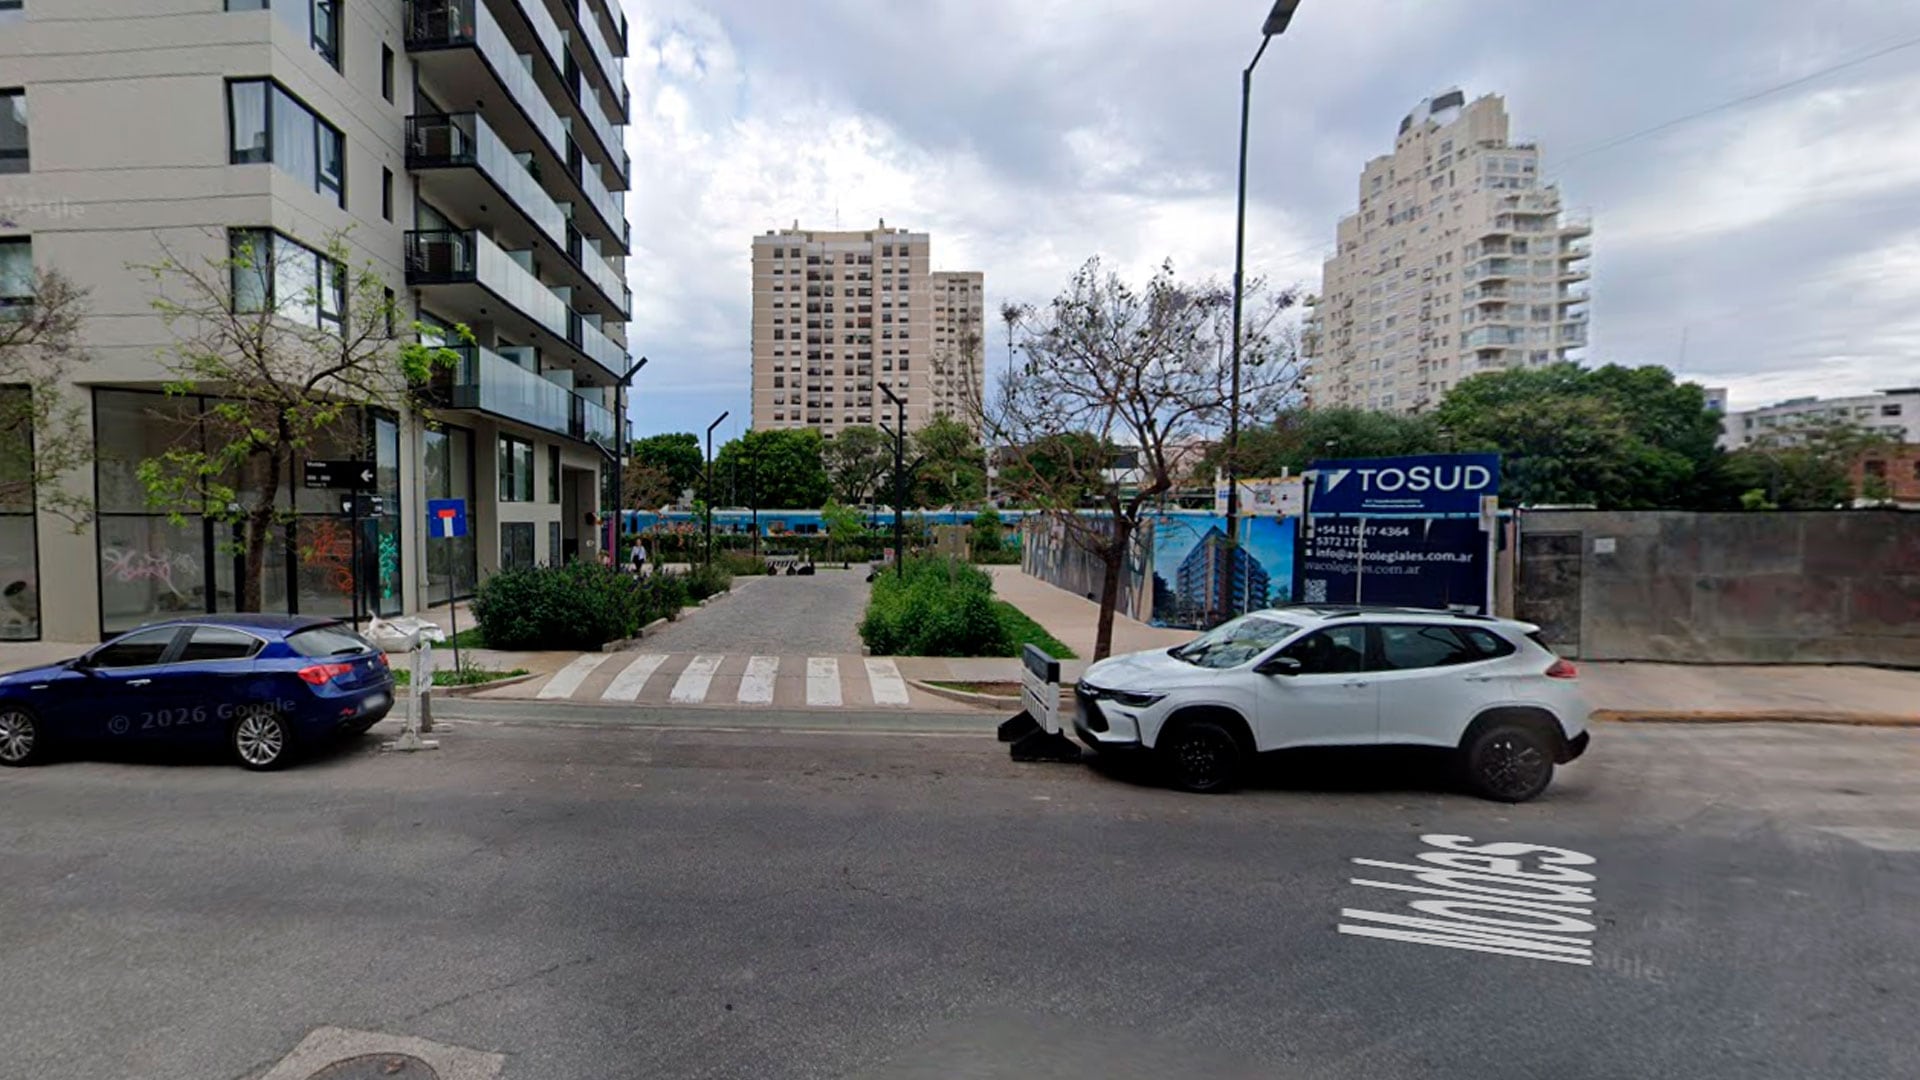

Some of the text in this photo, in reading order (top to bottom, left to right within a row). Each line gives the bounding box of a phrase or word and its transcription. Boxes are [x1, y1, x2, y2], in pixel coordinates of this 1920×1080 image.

[1357, 465, 1491, 491] TOSUD
[1316, 525, 1336, 535] +54
[1338, 525, 1350, 536] 11
[1352, 525, 1377, 537] 647
